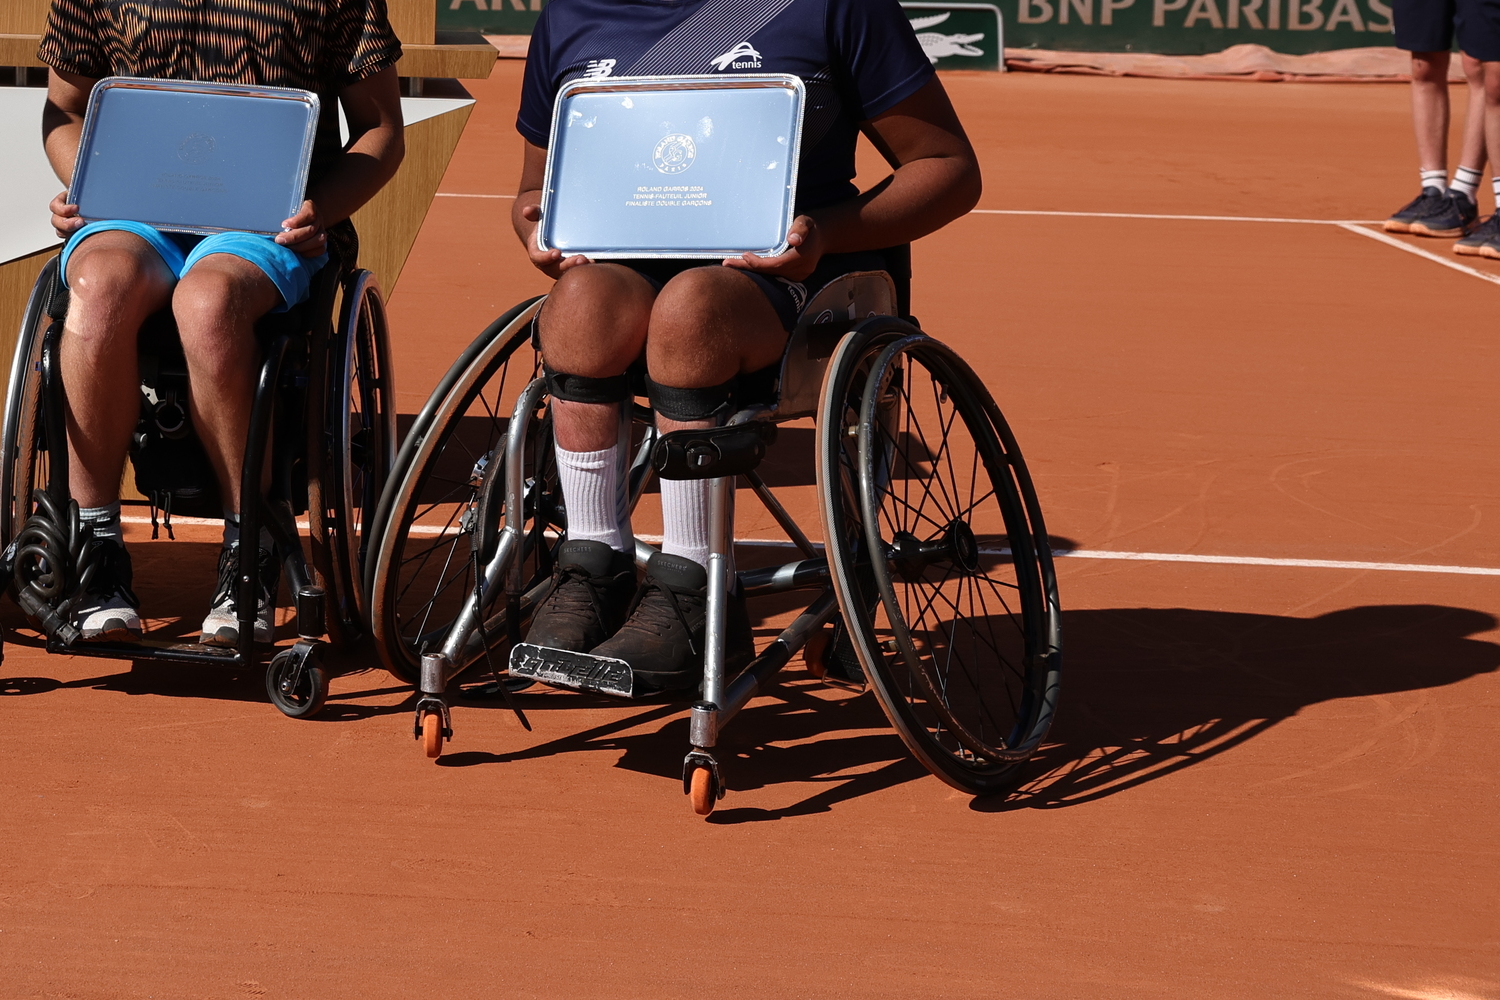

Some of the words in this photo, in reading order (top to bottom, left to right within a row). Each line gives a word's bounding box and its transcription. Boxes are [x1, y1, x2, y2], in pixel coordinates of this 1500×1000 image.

[732, 60, 761, 69] tennis
[787, 285, 801, 314] tennis
[563, 546, 592, 554] SKECHERS
[657, 560, 688, 572] SKECHERS
